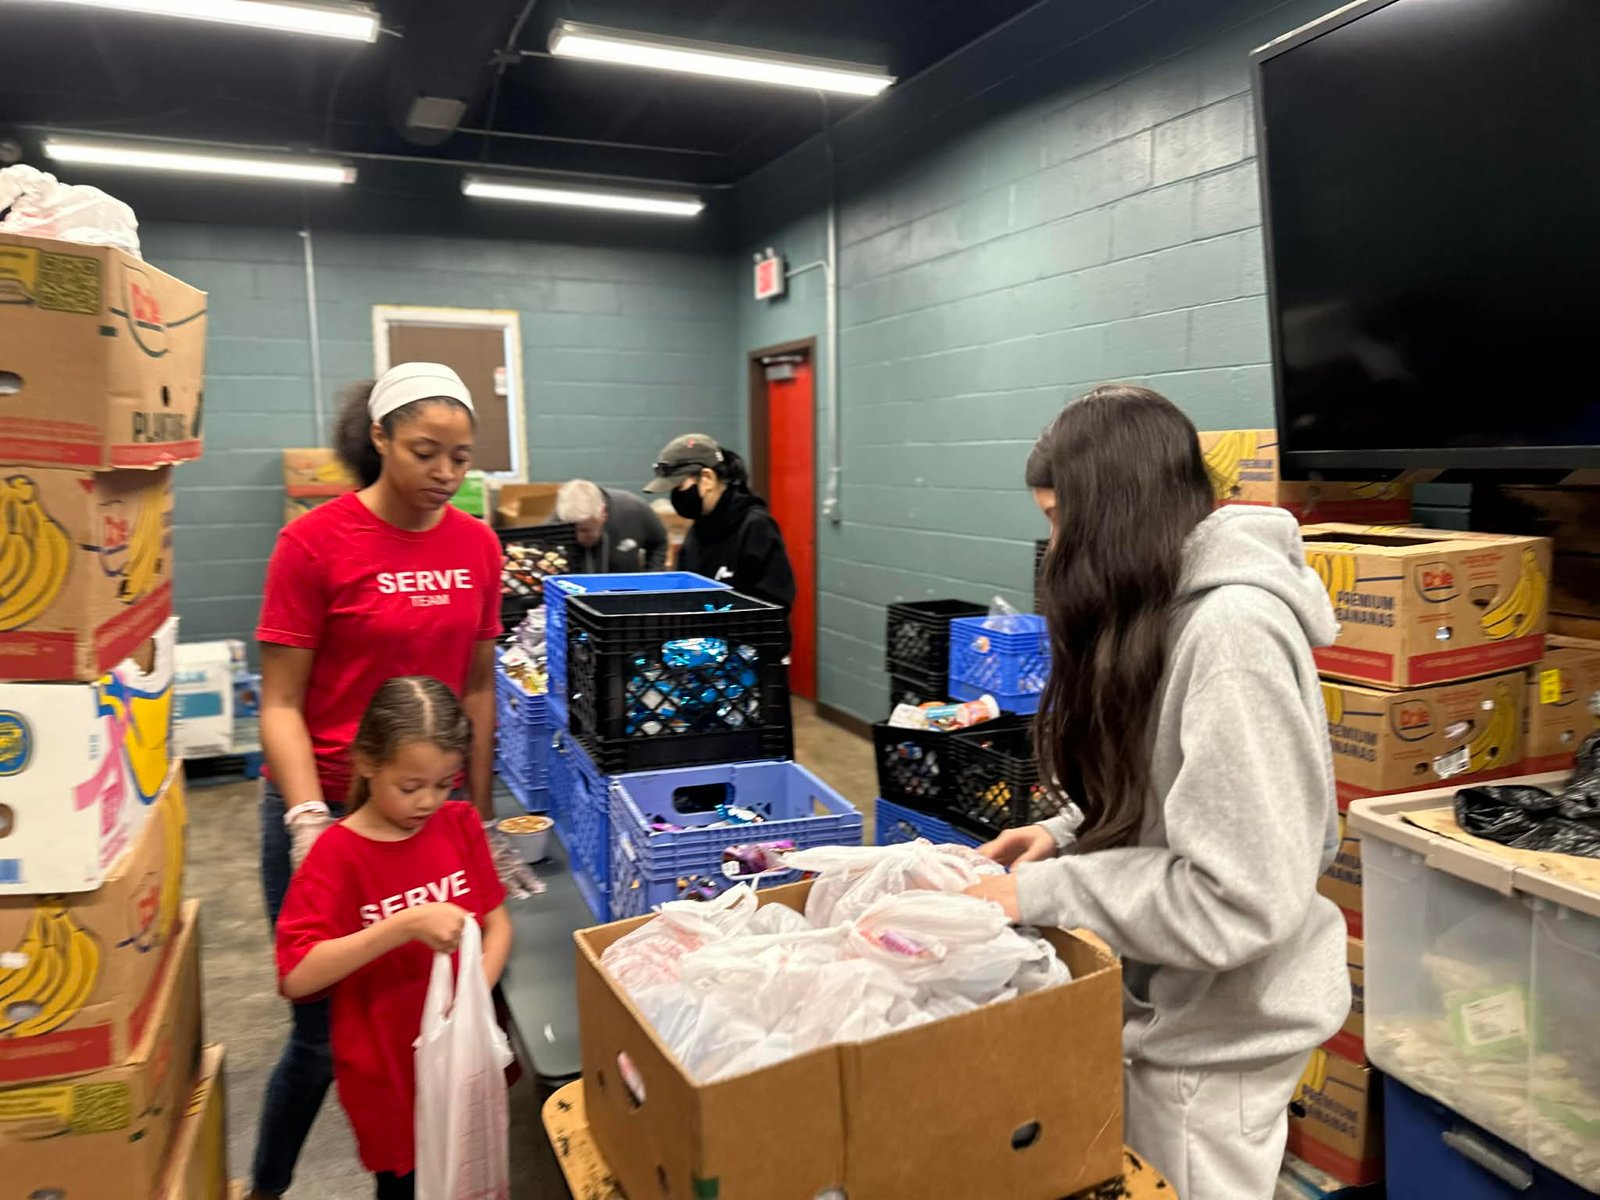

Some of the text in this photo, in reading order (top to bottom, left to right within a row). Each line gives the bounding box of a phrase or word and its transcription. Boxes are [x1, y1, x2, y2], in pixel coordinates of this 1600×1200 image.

[376, 568, 473, 594] SERVE
[408, 594, 451, 607] TEAM
[1336, 590, 1395, 610] PREMIUM
[1334, 607, 1395, 628] BANANAS
[1328, 723, 1378, 746] REMIUM
[359, 869, 471, 928] SERVE
